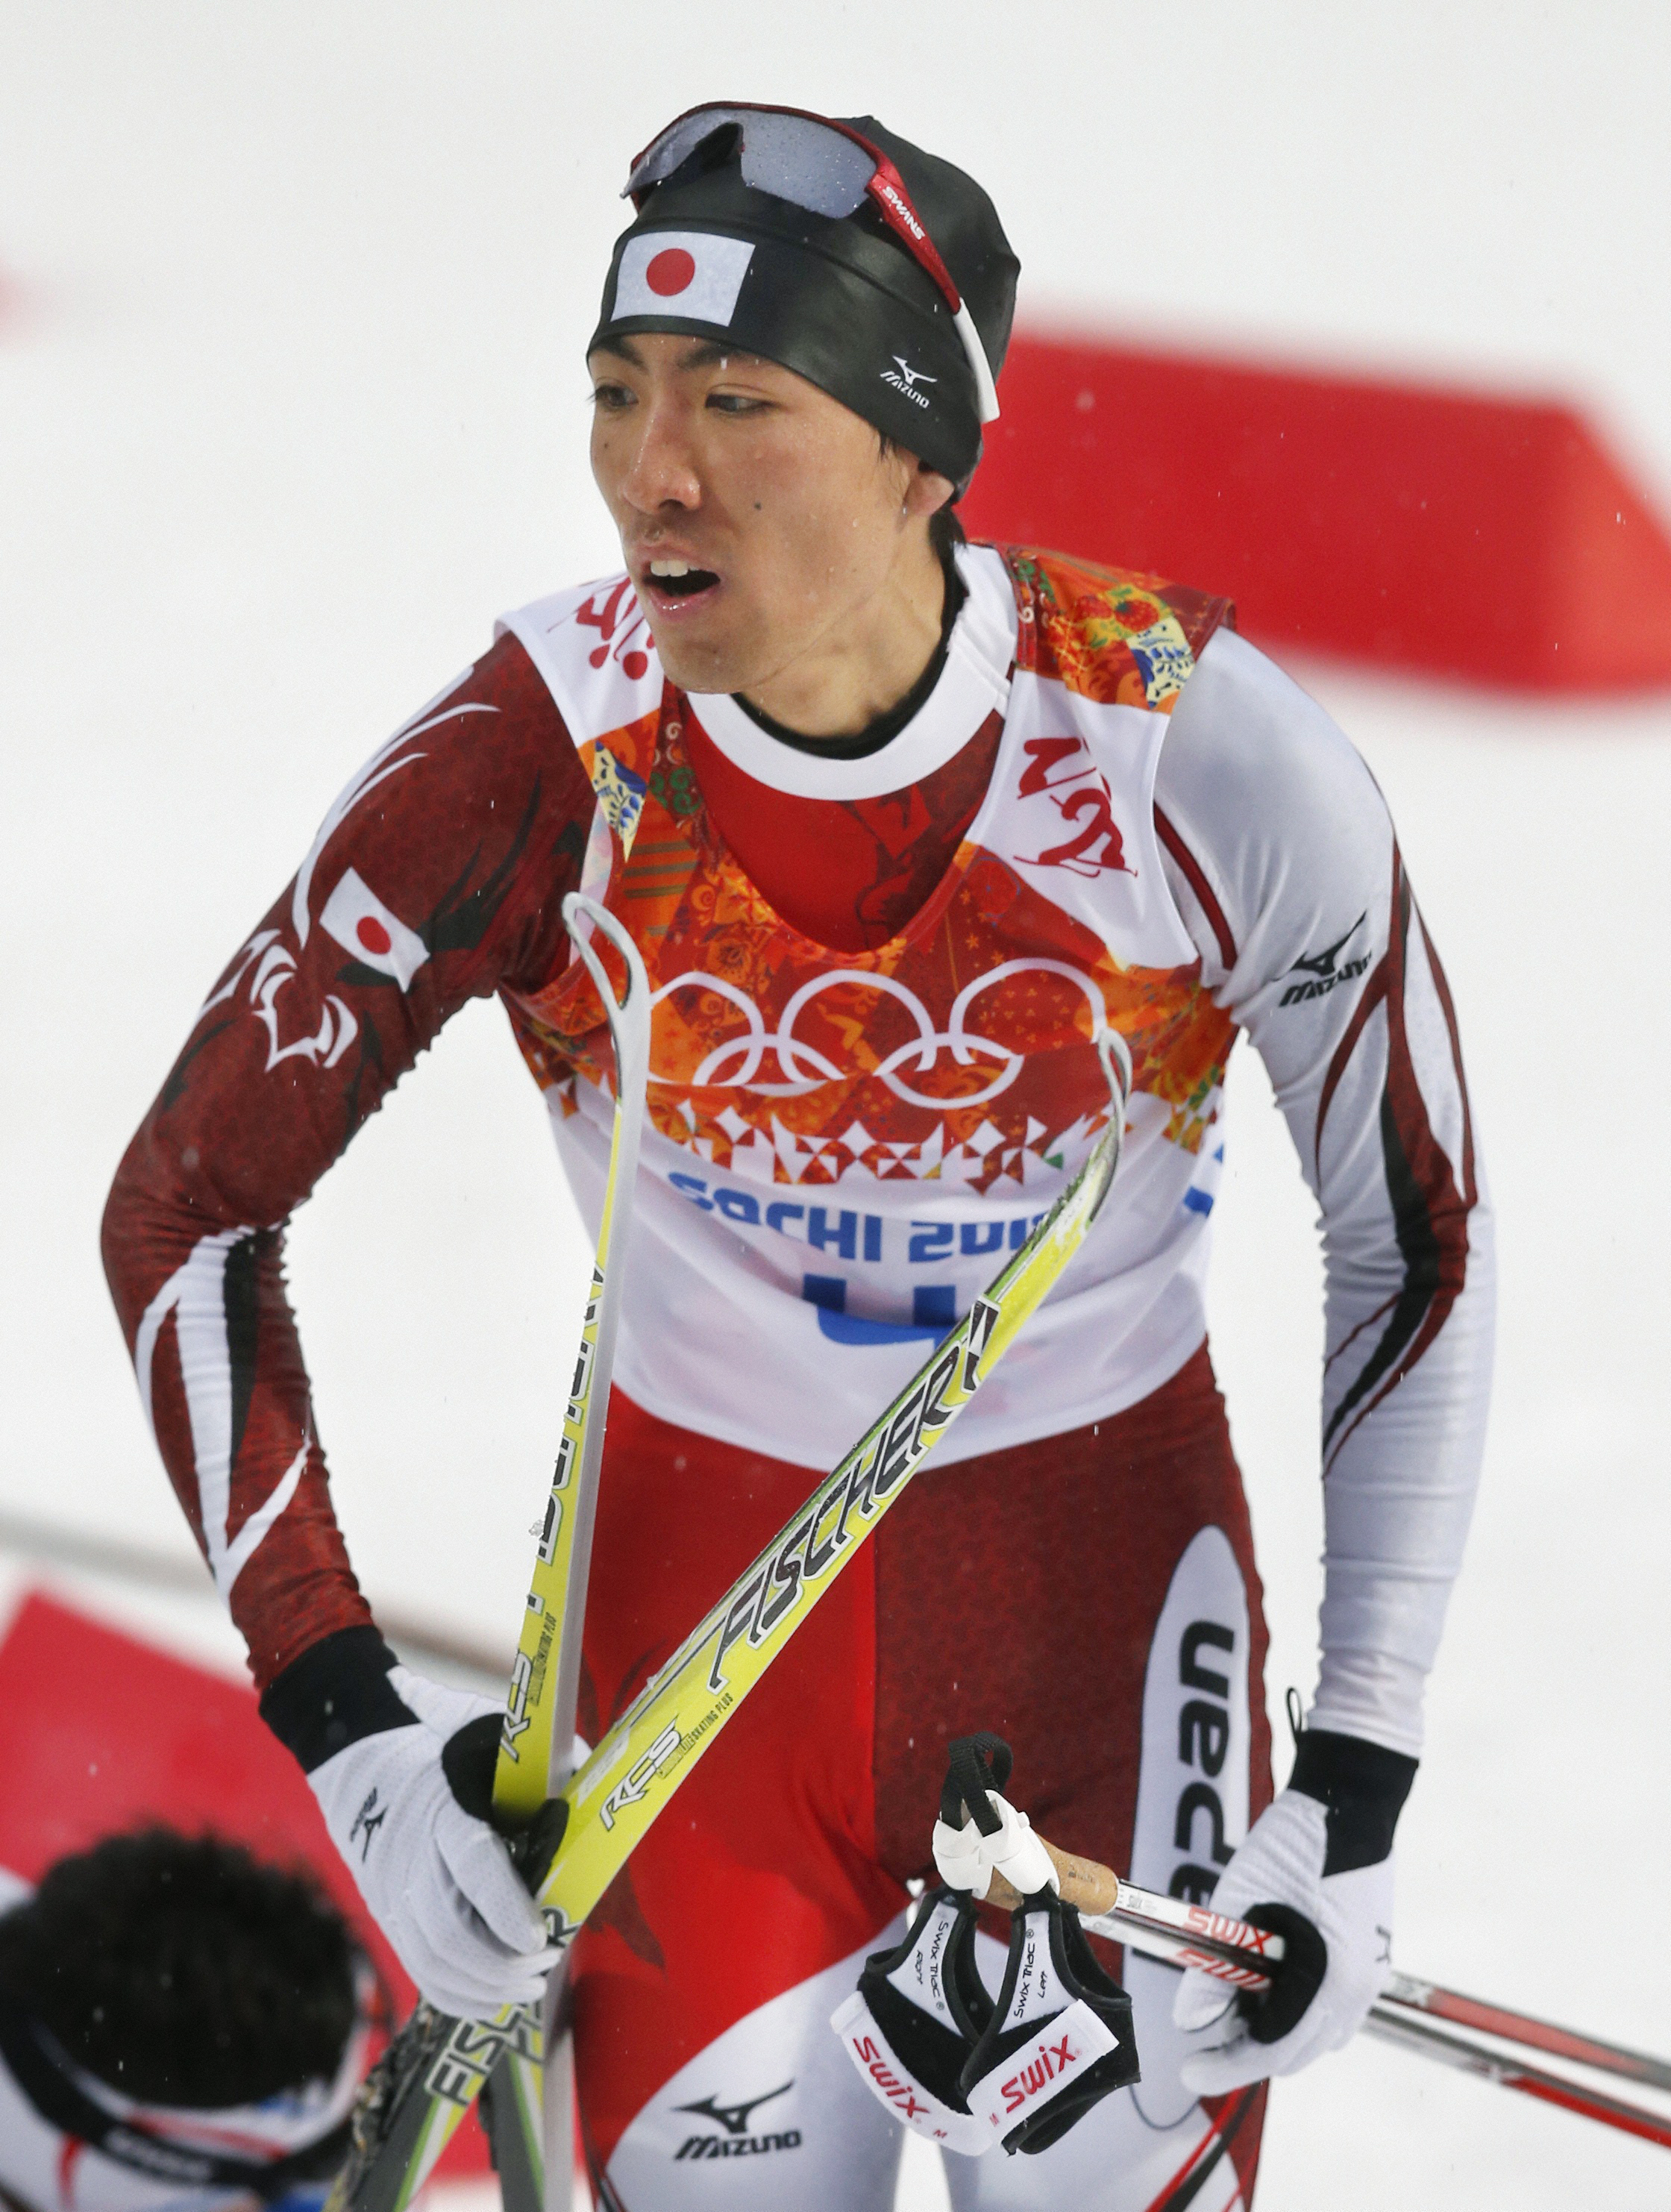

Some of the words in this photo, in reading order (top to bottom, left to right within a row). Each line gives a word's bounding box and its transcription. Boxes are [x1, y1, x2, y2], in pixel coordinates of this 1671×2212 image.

[882, 186, 925, 239] SWANS
[880, 371, 929, 409] MIZUNO
[909, 1210, 1048, 1262] 201
[707, 1341, 968, 1694] FISCHER
[691, 1710, 718, 1741] SKATING
[715, 1692, 733, 1714] PLUS
[674, 2129, 802, 2161] MIZUNO
